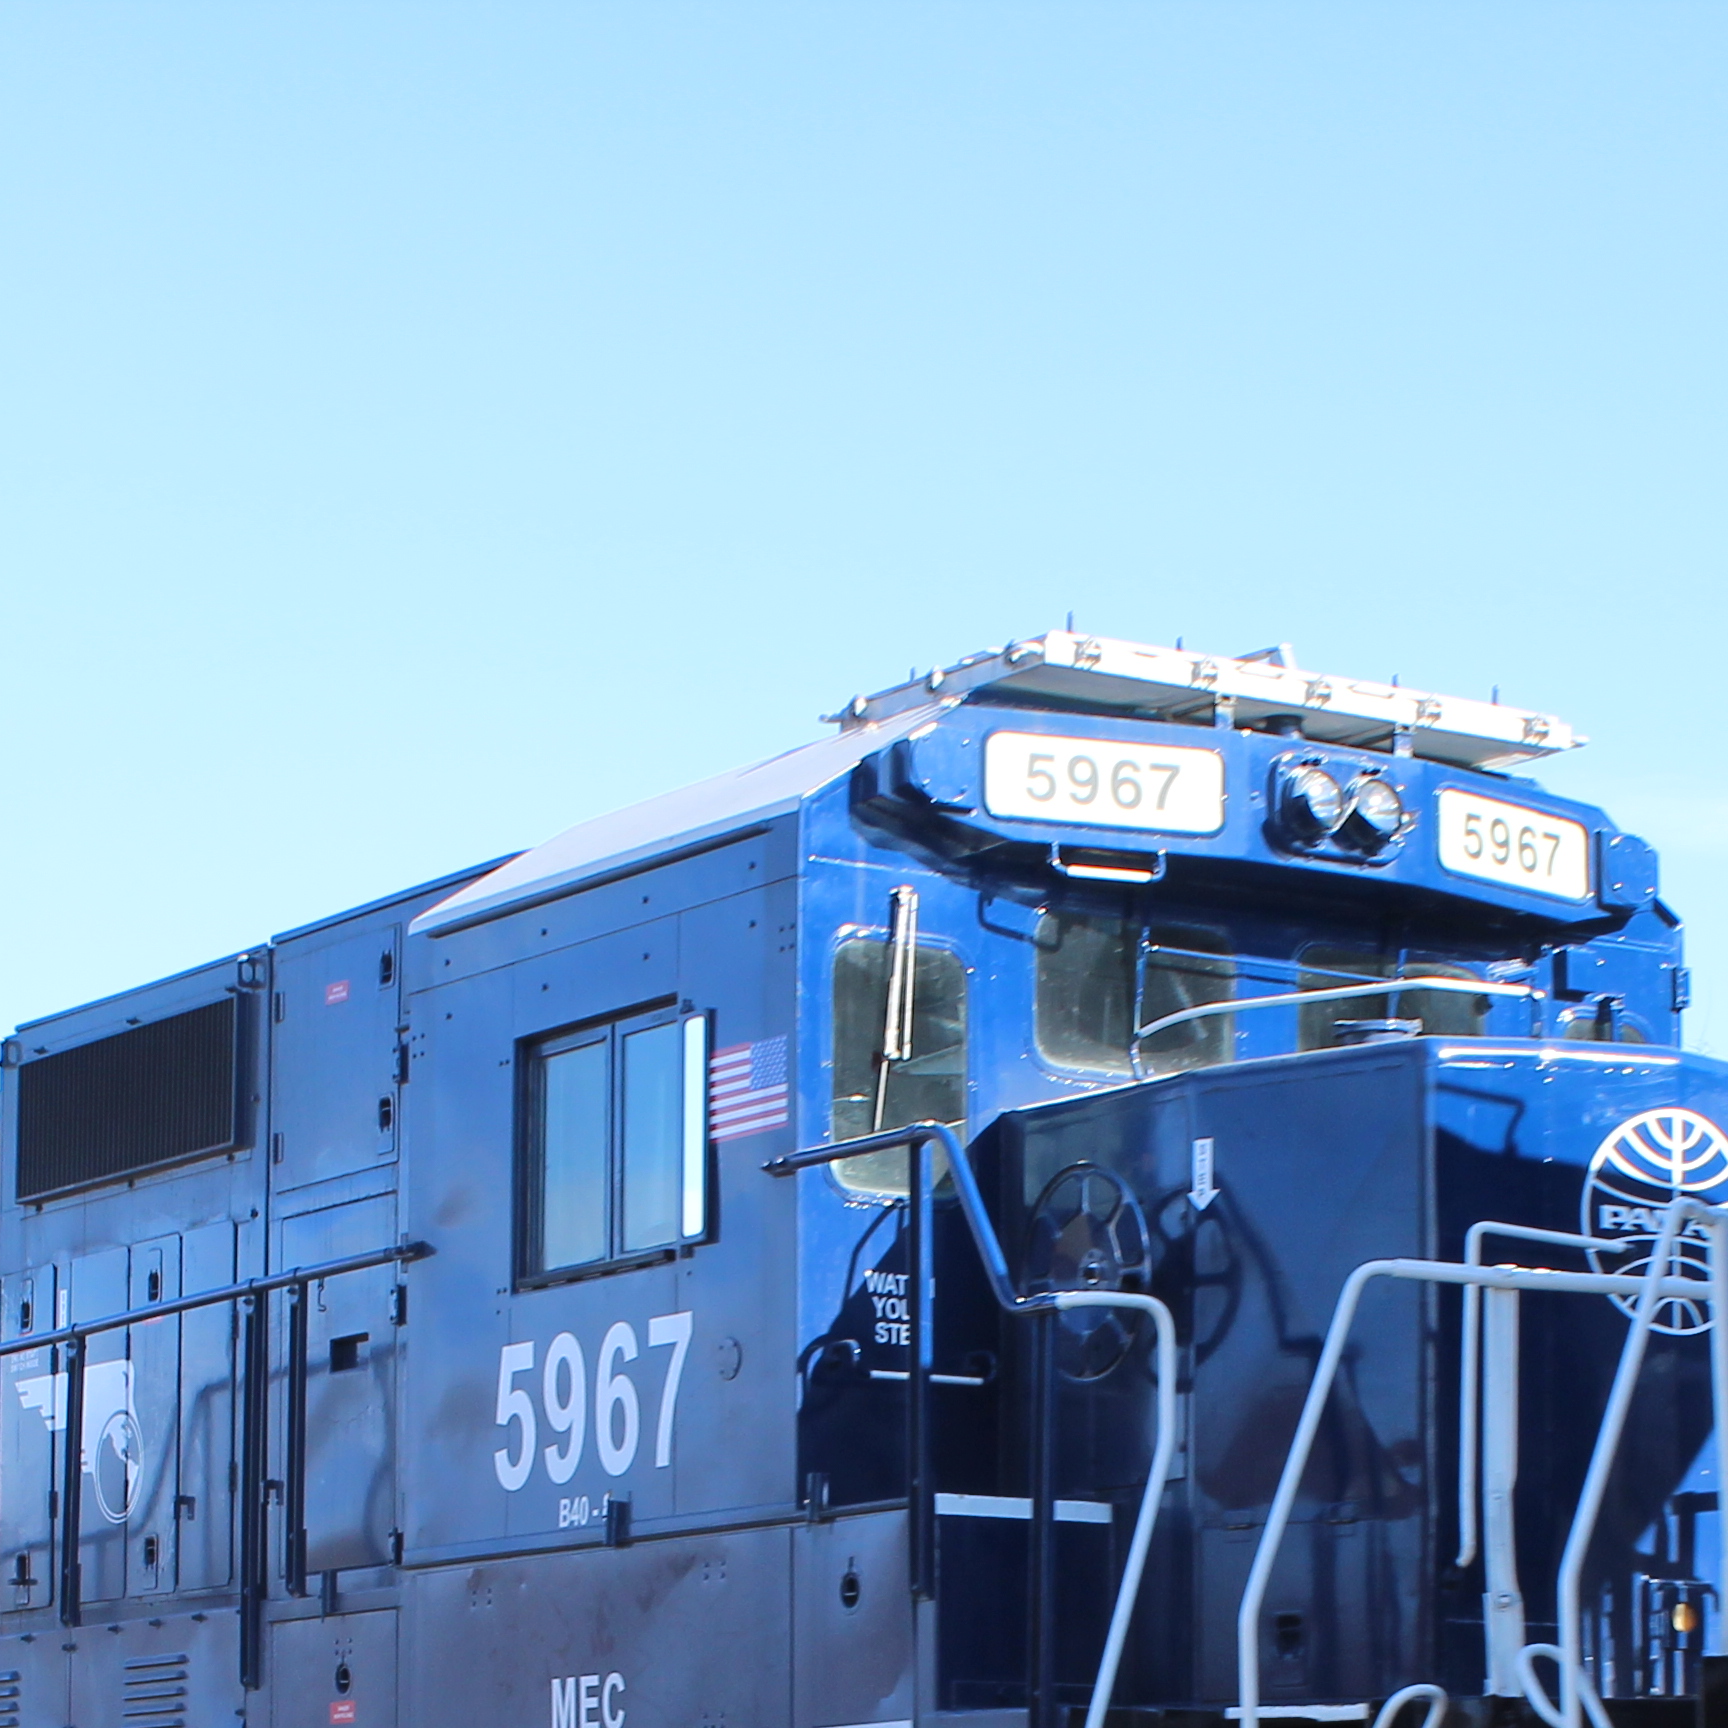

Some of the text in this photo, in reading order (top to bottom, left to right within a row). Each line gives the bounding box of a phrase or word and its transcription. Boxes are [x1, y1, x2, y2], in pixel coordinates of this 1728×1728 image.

[1026, 751, 1182, 813] 5967
[1462, 812, 1563, 879] 5967
[864, 1271, 911, 1297] WAT
[874, 1321, 911, 1347] STE
[493, 1310, 694, 1493] 5967
